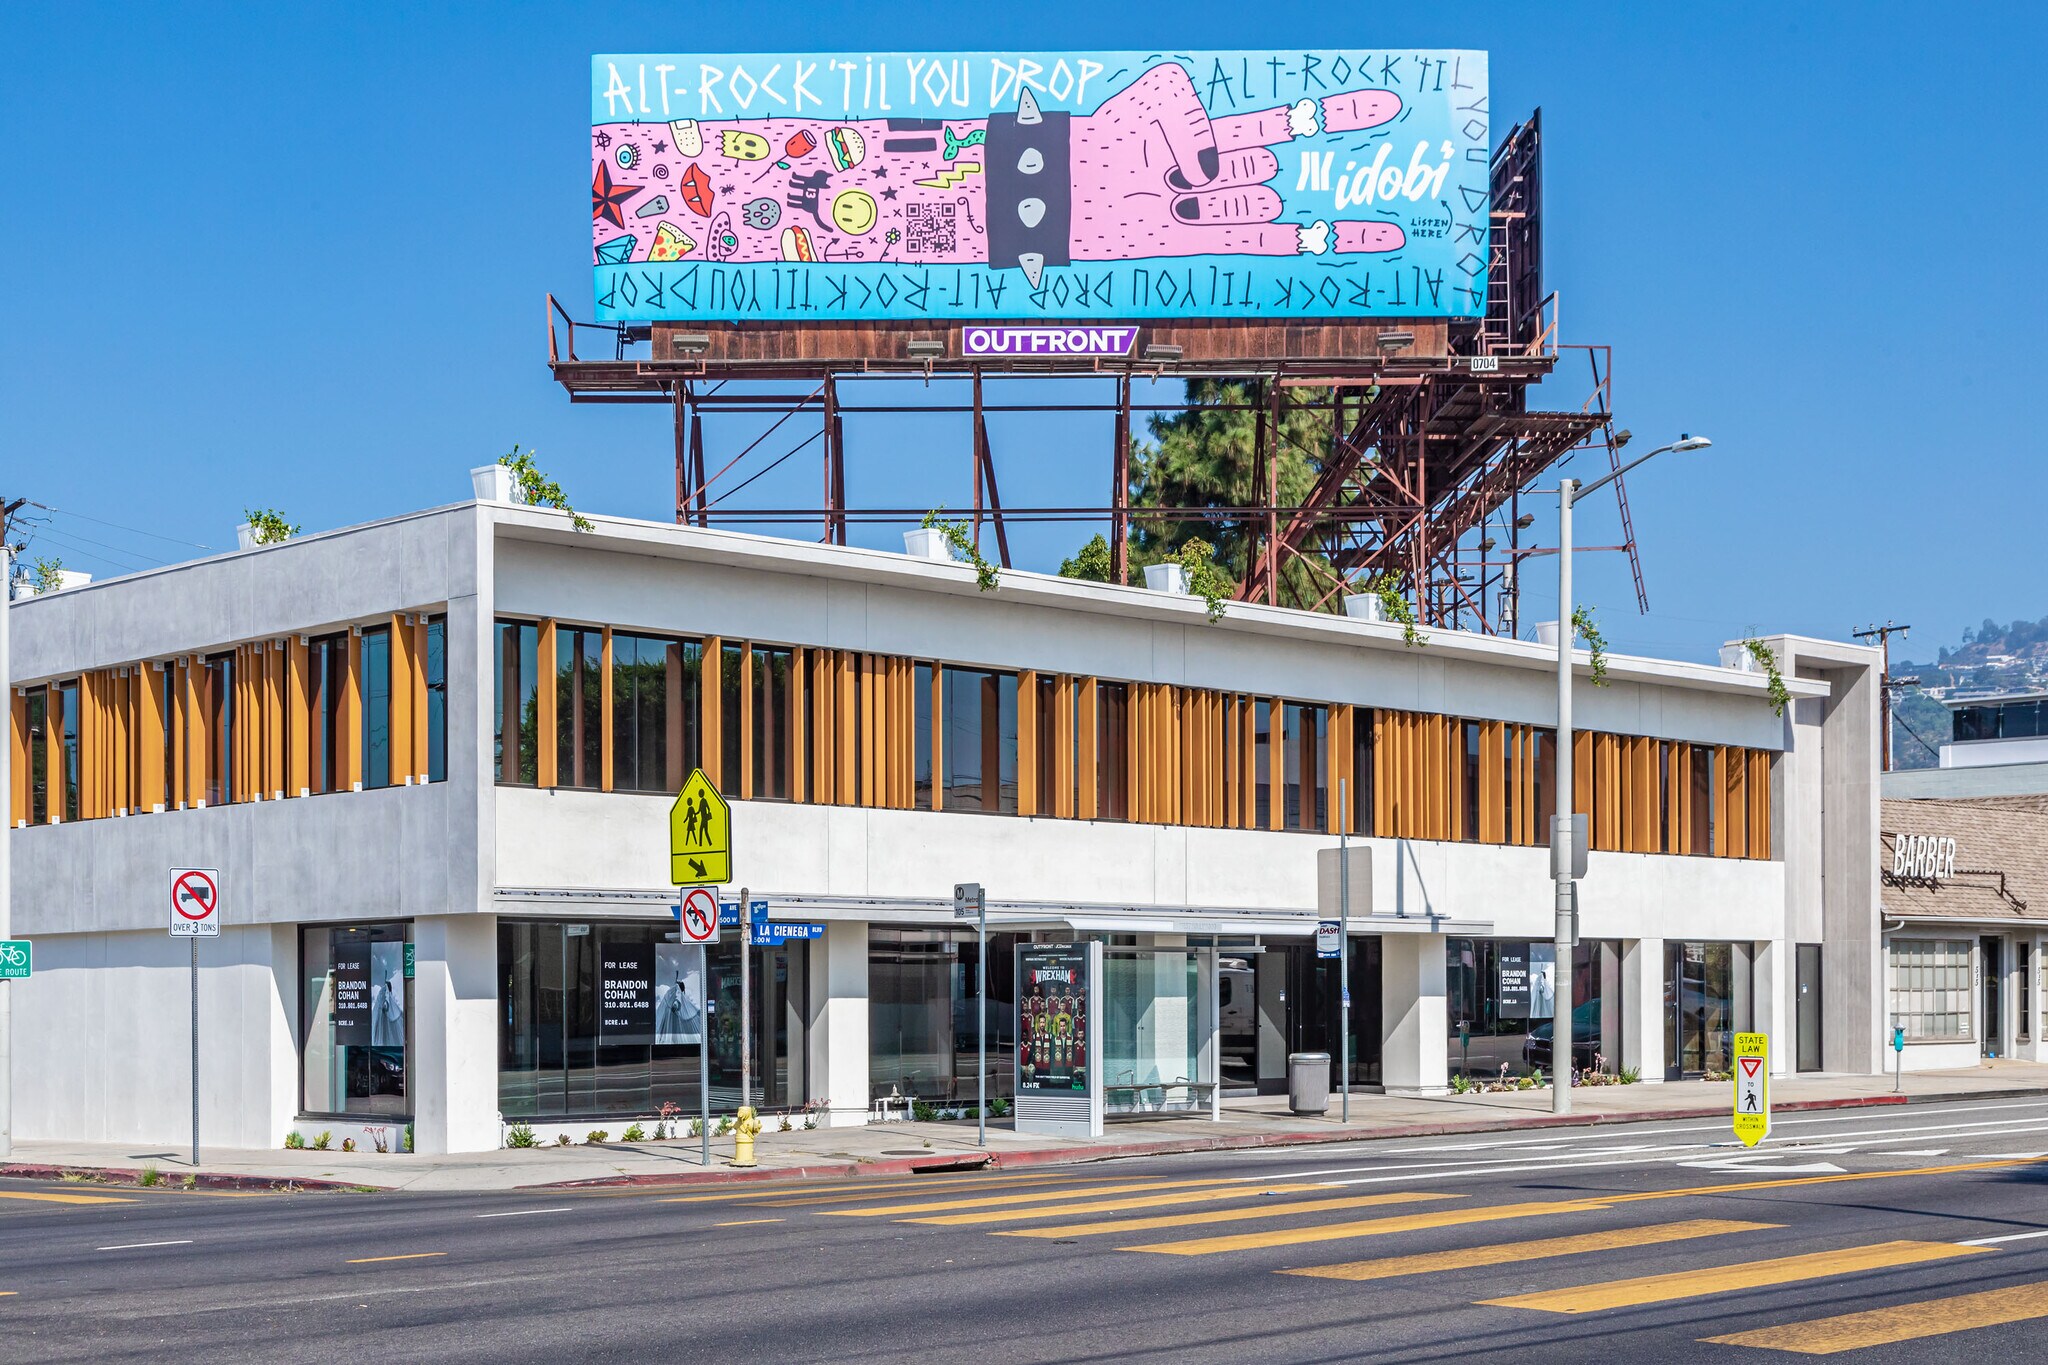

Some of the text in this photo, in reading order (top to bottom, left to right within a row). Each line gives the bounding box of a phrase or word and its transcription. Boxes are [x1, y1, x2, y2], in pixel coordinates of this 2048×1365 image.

[602, 60, 823, 117] ALT-ROCK
[906, 57, 970, 108] YOU
[989, 57, 1105, 109] DROP
[1207, 53, 1474, 111] ALT-ROCK 'TIL
[1334, 139, 1456, 211] idobi
[1453, 95, 1490, 309] YOU DROP
[1411, 229, 1443, 239] HERE
[597, 263, 1008, 312] ALT-ROCK 'TIL YOU DROP
[1028, 265, 1444, 310] ALT-ROCK 'TIL YOU DROP
[968, 329, 1130, 353] OUTFRONT
[1472, 358, 1496, 370] 0704
[1892, 833, 1957, 879] BARBER
[731, 916, 738, 924] W
[173, 921, 217, 934] OVER 3 TONS
[759, 924, 770, 936] LA
[773, 925, 809, 937] CIENEGA
[754, 936, 766, 944] 500
[338, 962, 360, 970] FOR LEASE
[604, 961, 638, 969] FOR LEASE
[4, 967, 28, 976] ROUTE
[1501, 970, 1527, 978] BRANDON
[1035, 969, 1071, 985] WREXHAM
[1502, 977, 1521, 985] COHAN
[338, 980, 367, 990] BRANDON
[604, 980, 648, 990] BRANDON
[338, 990, 360, 1000] COHAN
[604, 990, 637, 1000] COHAN
[1738, 1036, 1764, 1045] STATE
[1741, 1045, 1761, 1053] LAW
[1032, 1081, 1040, 1089] FX
